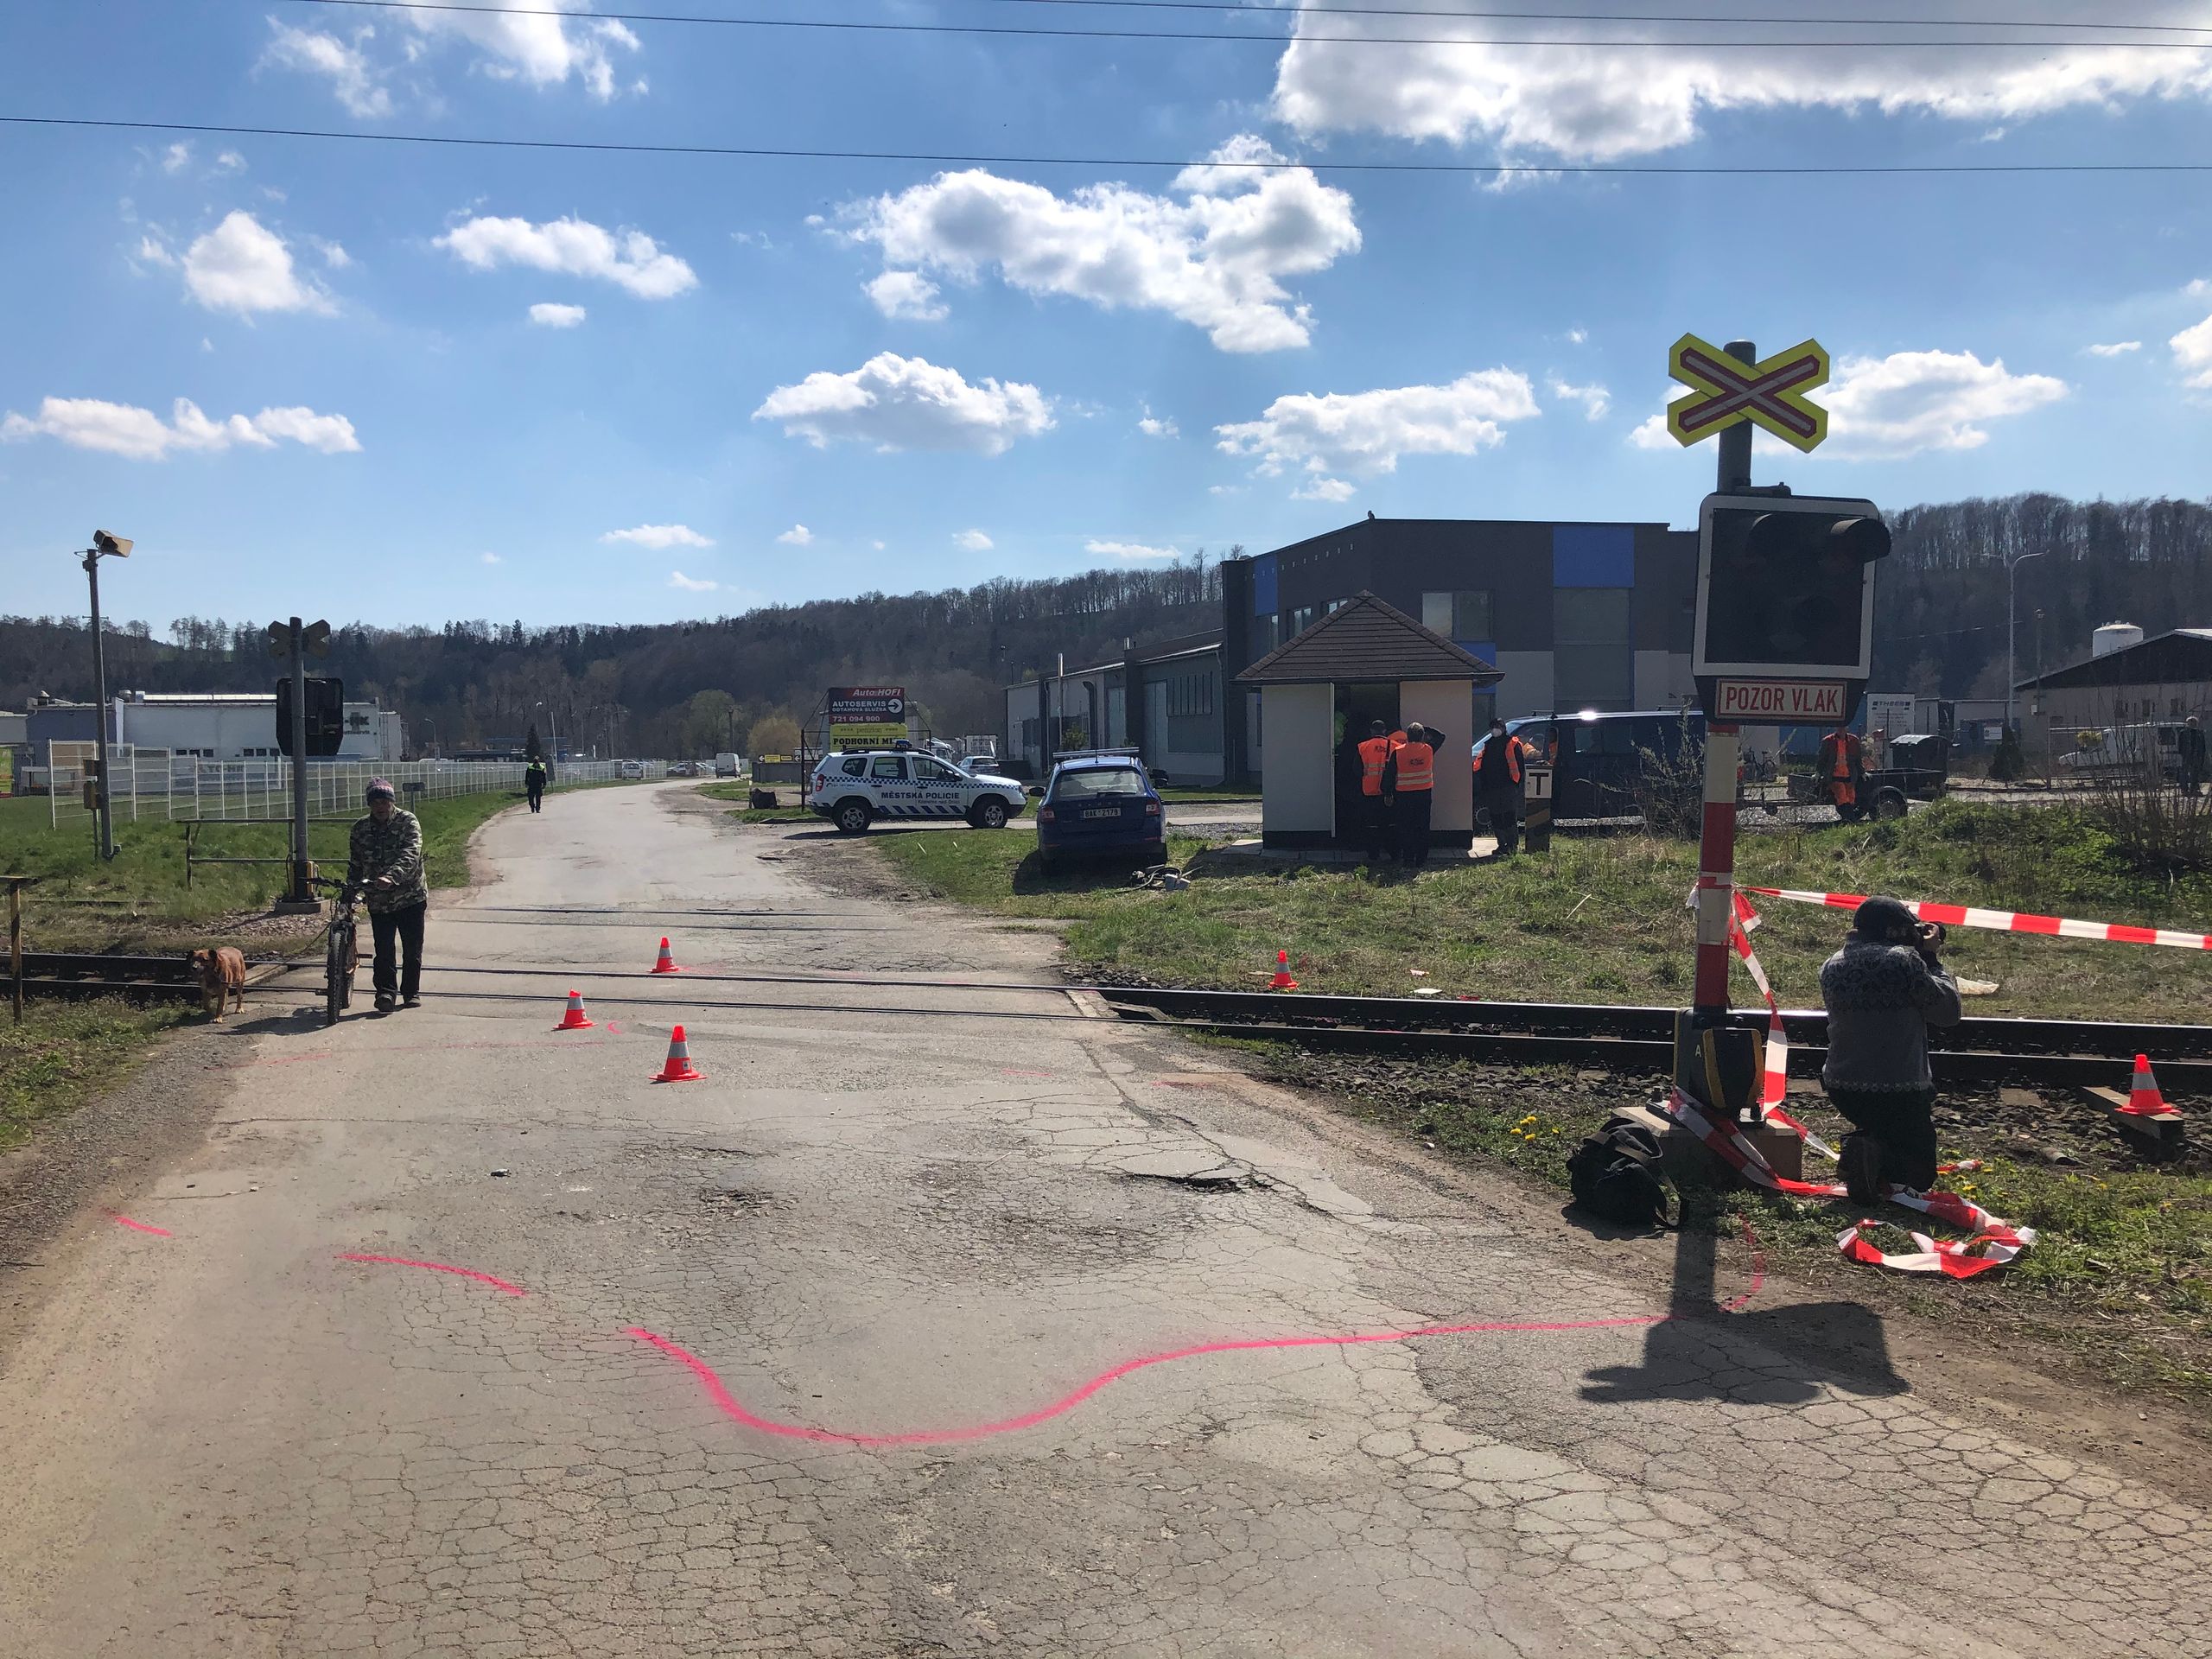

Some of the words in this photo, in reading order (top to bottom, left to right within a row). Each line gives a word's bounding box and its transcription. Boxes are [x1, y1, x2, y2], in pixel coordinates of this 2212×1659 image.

[1726, 686, 1785, 711] POZOR
[1792, 688, 1838, 713] VLAK
[1529, 772, 1549, 796] T
[881, 791, 923, 799] MĚSTSKÁ
[1694, 1044, 1702, 1058] A
